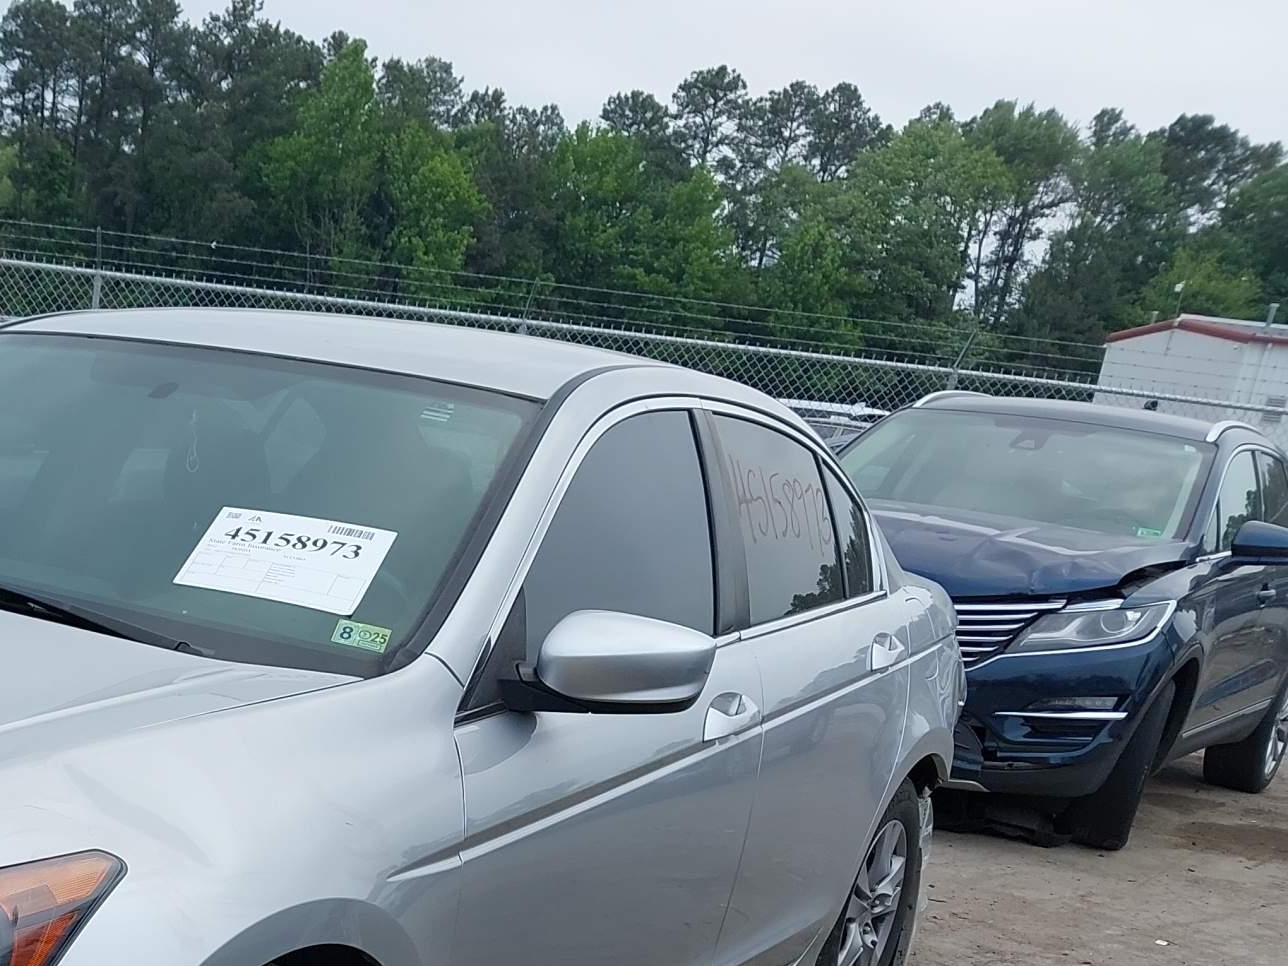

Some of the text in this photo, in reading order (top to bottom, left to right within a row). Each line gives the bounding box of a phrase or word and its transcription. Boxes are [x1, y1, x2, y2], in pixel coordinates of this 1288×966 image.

[224, 526, 363, 560] 45158973
[340, 626, 354, 640] 8
[371, 631, 388, 645] 25
